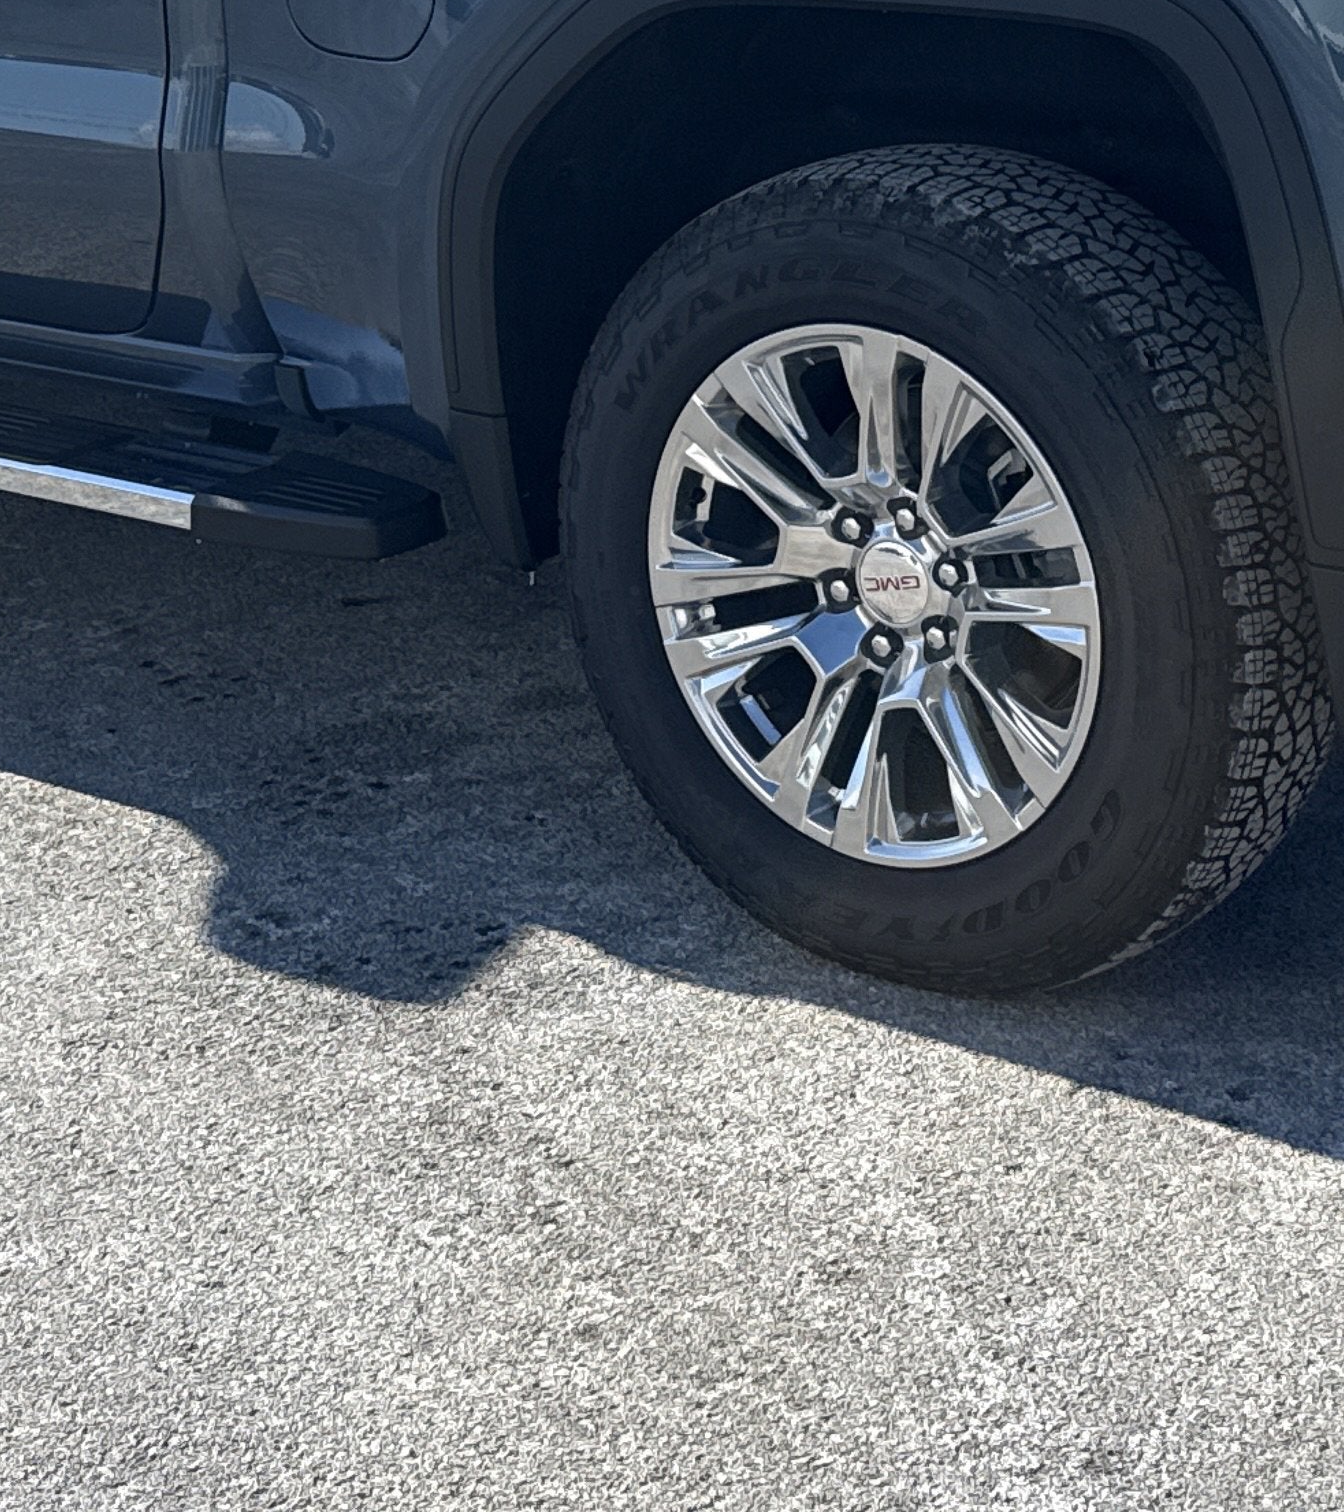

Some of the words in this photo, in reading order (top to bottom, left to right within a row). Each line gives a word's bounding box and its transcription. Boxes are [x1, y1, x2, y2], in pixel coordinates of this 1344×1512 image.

[613, 258, 990, 412] WRANGLER
[863, 575, 921, 592] GMC
[776, 788, 1122, 944] GOODYE
